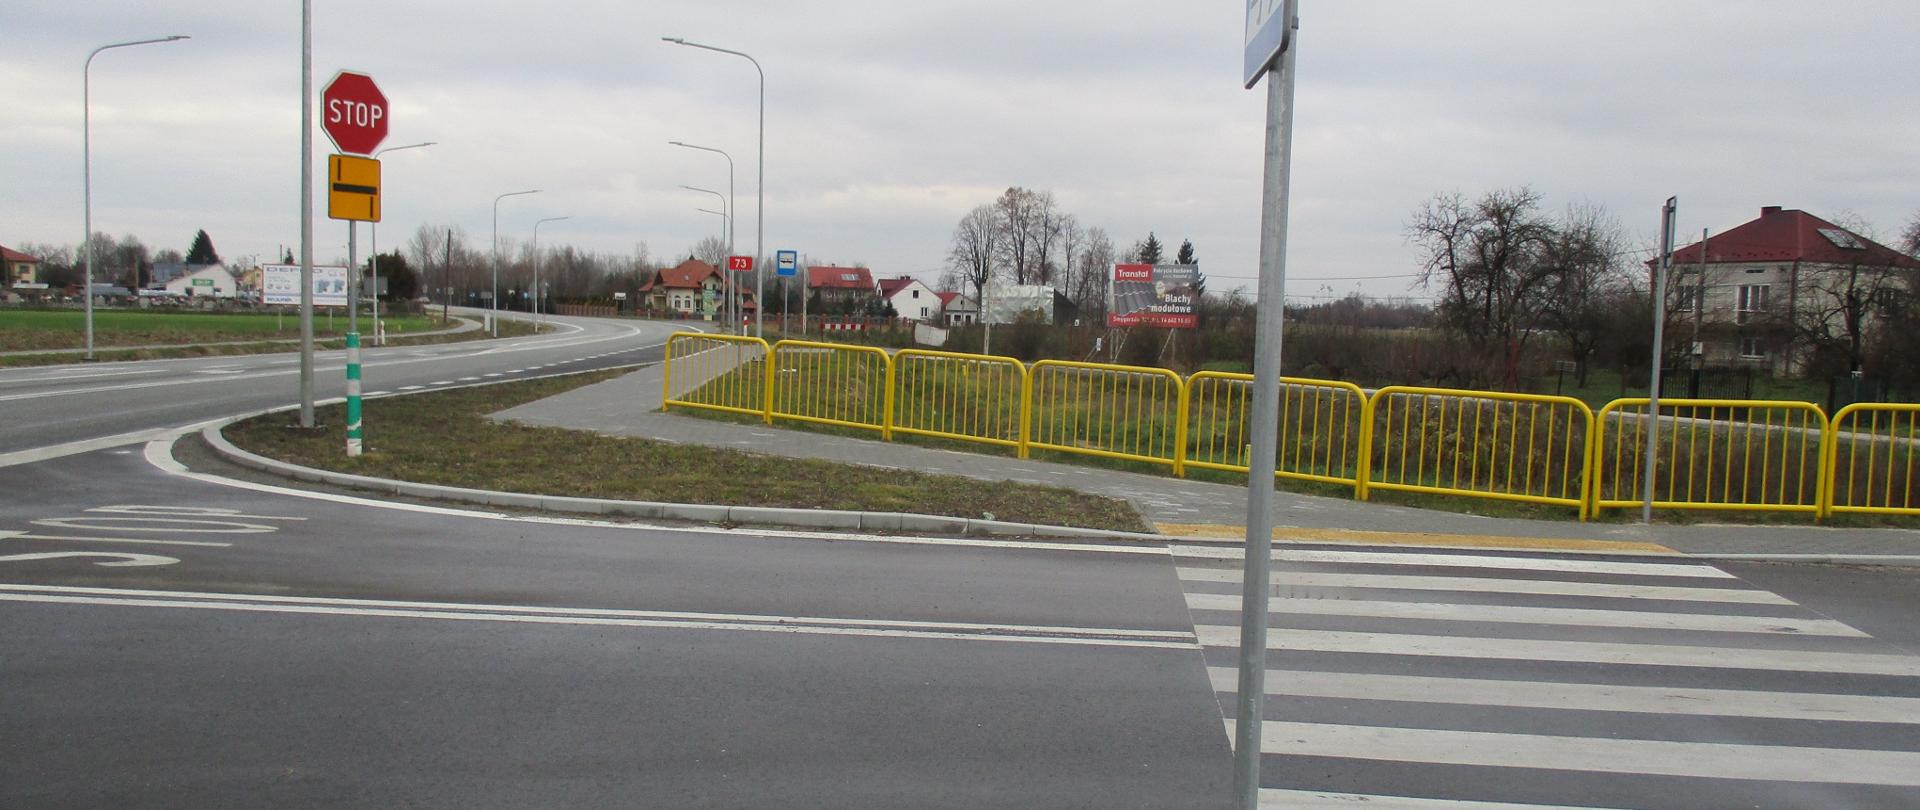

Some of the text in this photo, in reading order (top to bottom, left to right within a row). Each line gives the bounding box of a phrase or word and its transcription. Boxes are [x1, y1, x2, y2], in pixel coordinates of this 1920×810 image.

[330, 99, 383, 129] STOP
[735, 258, 747, 269] 73
[1165, 294, 1192, 304] Blachy
[1151, 304, 1192, 313] modułowe
